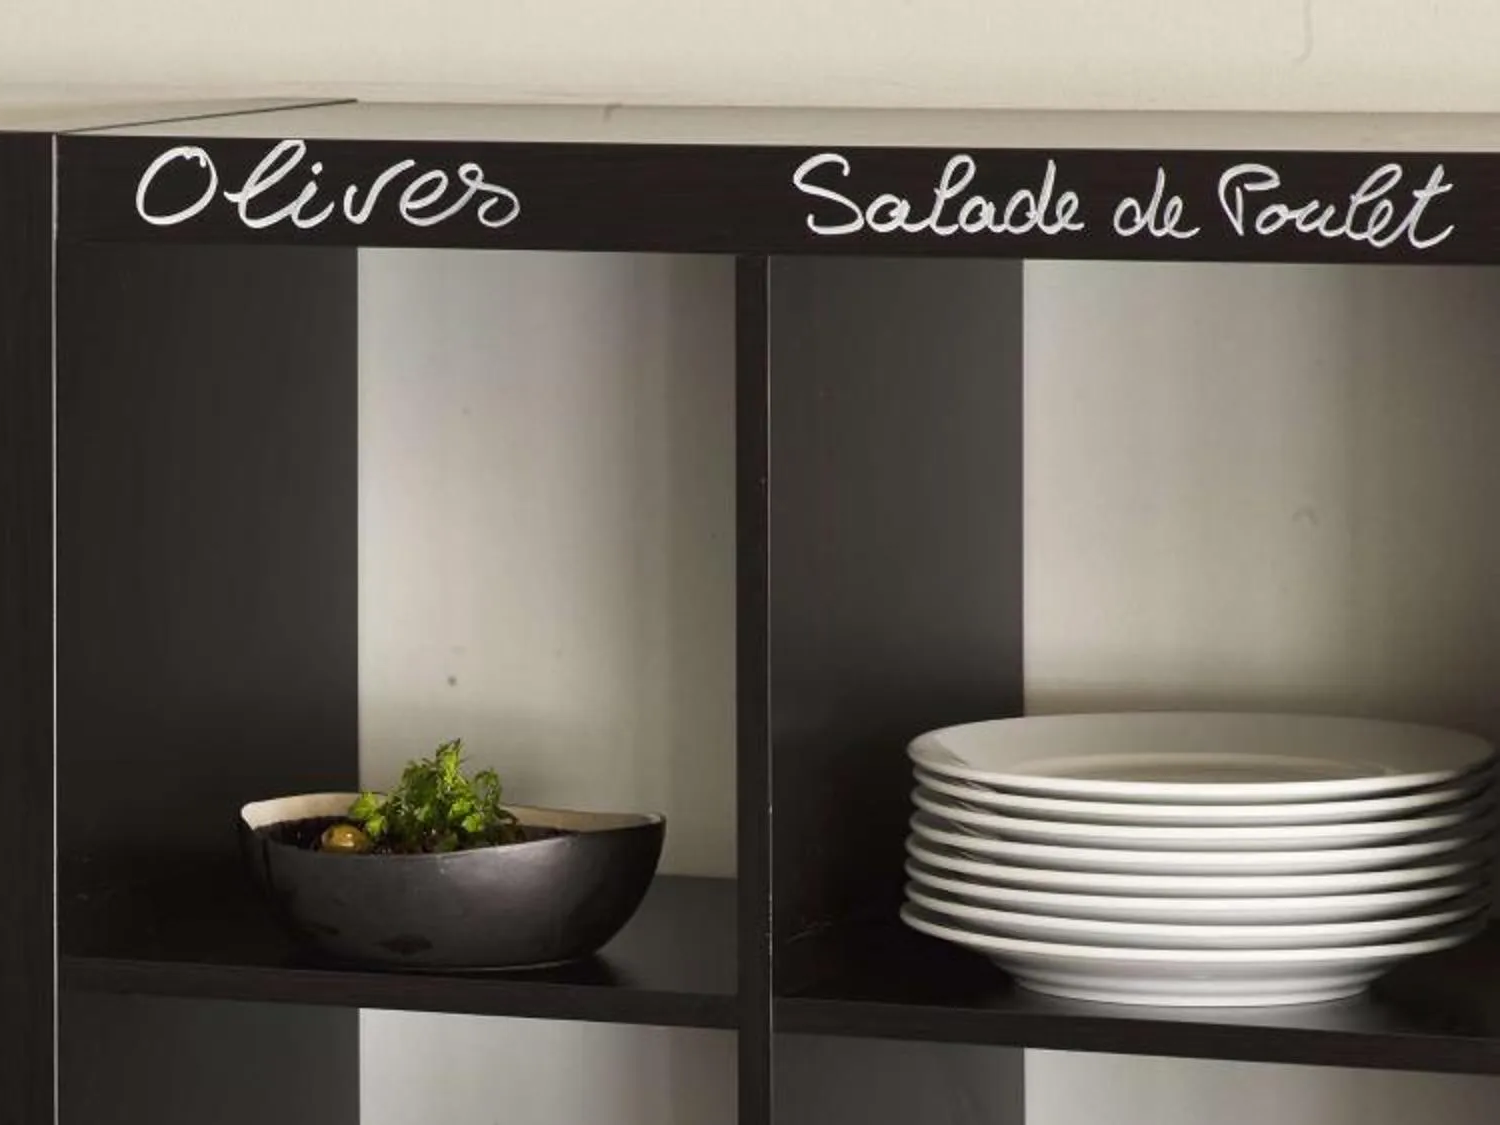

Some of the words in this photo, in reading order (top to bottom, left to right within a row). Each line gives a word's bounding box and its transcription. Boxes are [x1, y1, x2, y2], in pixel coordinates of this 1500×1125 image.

[135, 138, 520, 229] Olives
[790, 153, 1085, 237] Salade
[1113, 167, 1201, 239] de
[1217, 162, 1455, 249] Poulet
